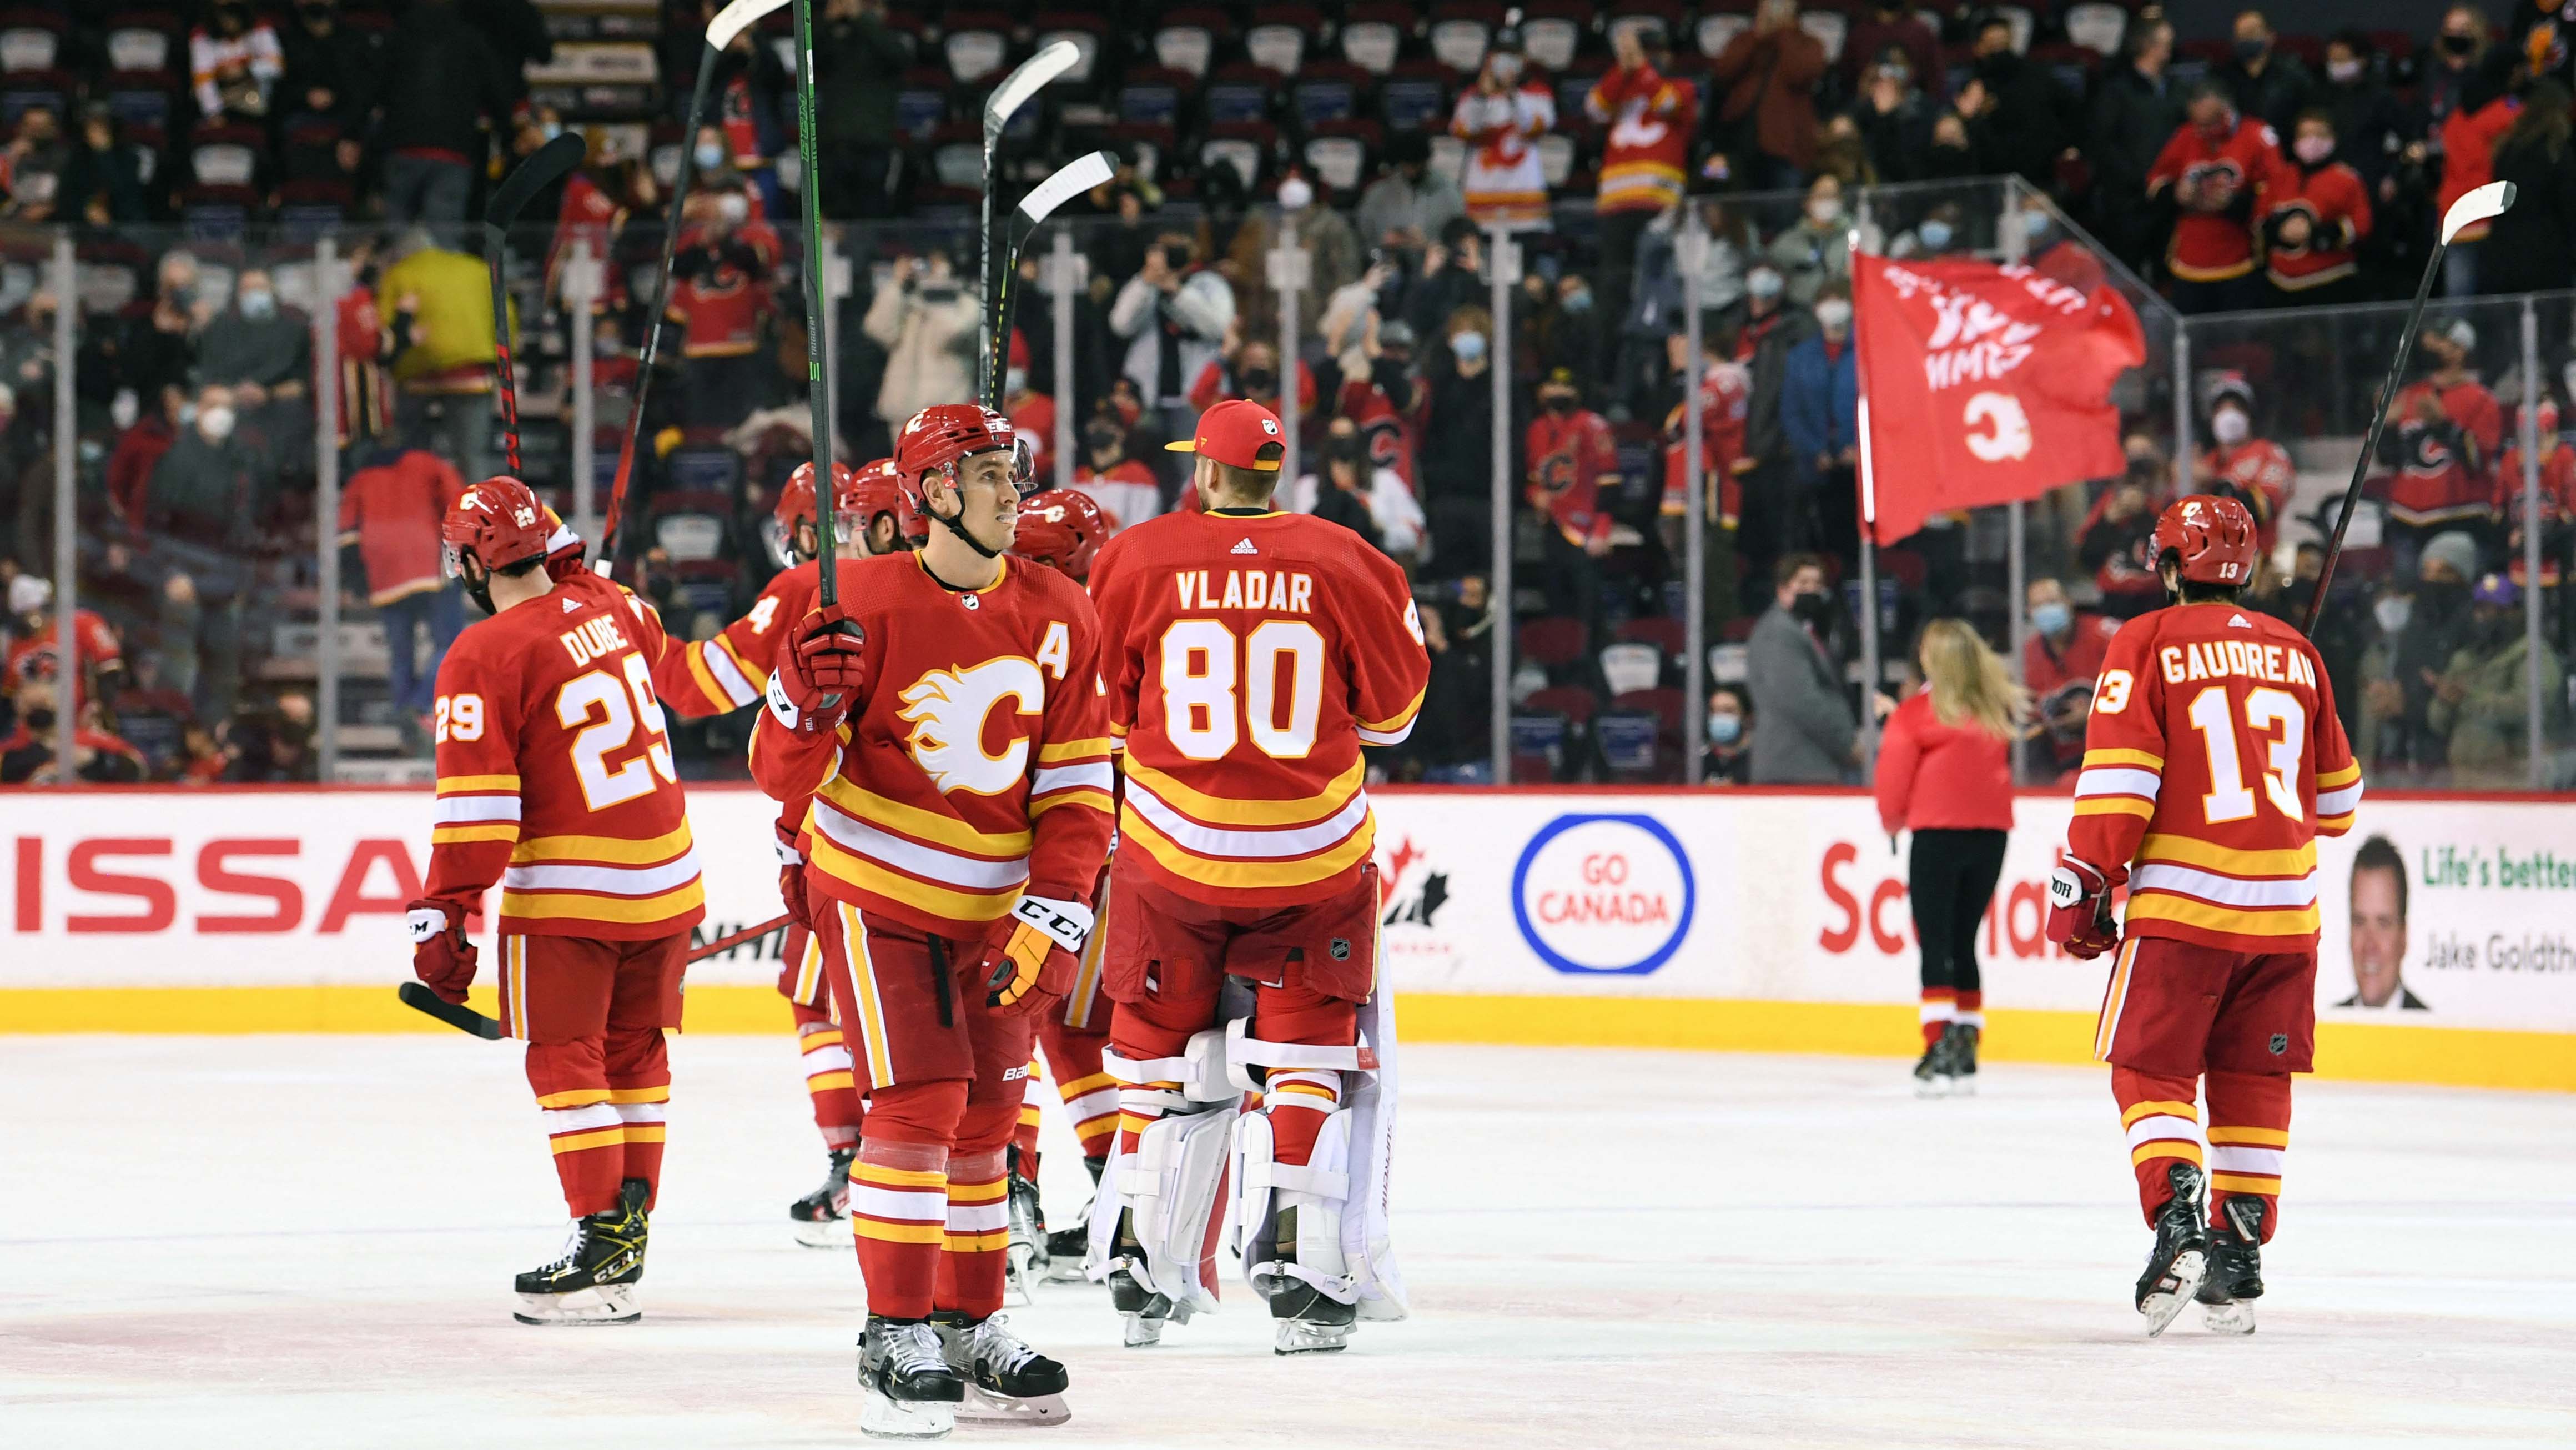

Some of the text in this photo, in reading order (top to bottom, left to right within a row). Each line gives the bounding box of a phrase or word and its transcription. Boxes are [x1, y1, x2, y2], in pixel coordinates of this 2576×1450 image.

[1175, 570, 1312, 614] VLADAR
[2218, 561, 2239, 579] 13
[559, 614, 628, 668] DUBE
[1036, 620, 1069, 680] A
[2160, 640, 2317, 691] GAUDREAU
[1159, 618, 1326, 761] 80
[435, 693, 484, 745] 29
[554, 651, 677, 813] 29
[2187, 685, 2306, 825] 13
[1583, 853, 1629, 885] GO
[2422, 845, 2576, 888] Life's bette
[1538, 892, 1669, 924] CANADA
[2425, 932, 2576, 971] Jake Goldth
